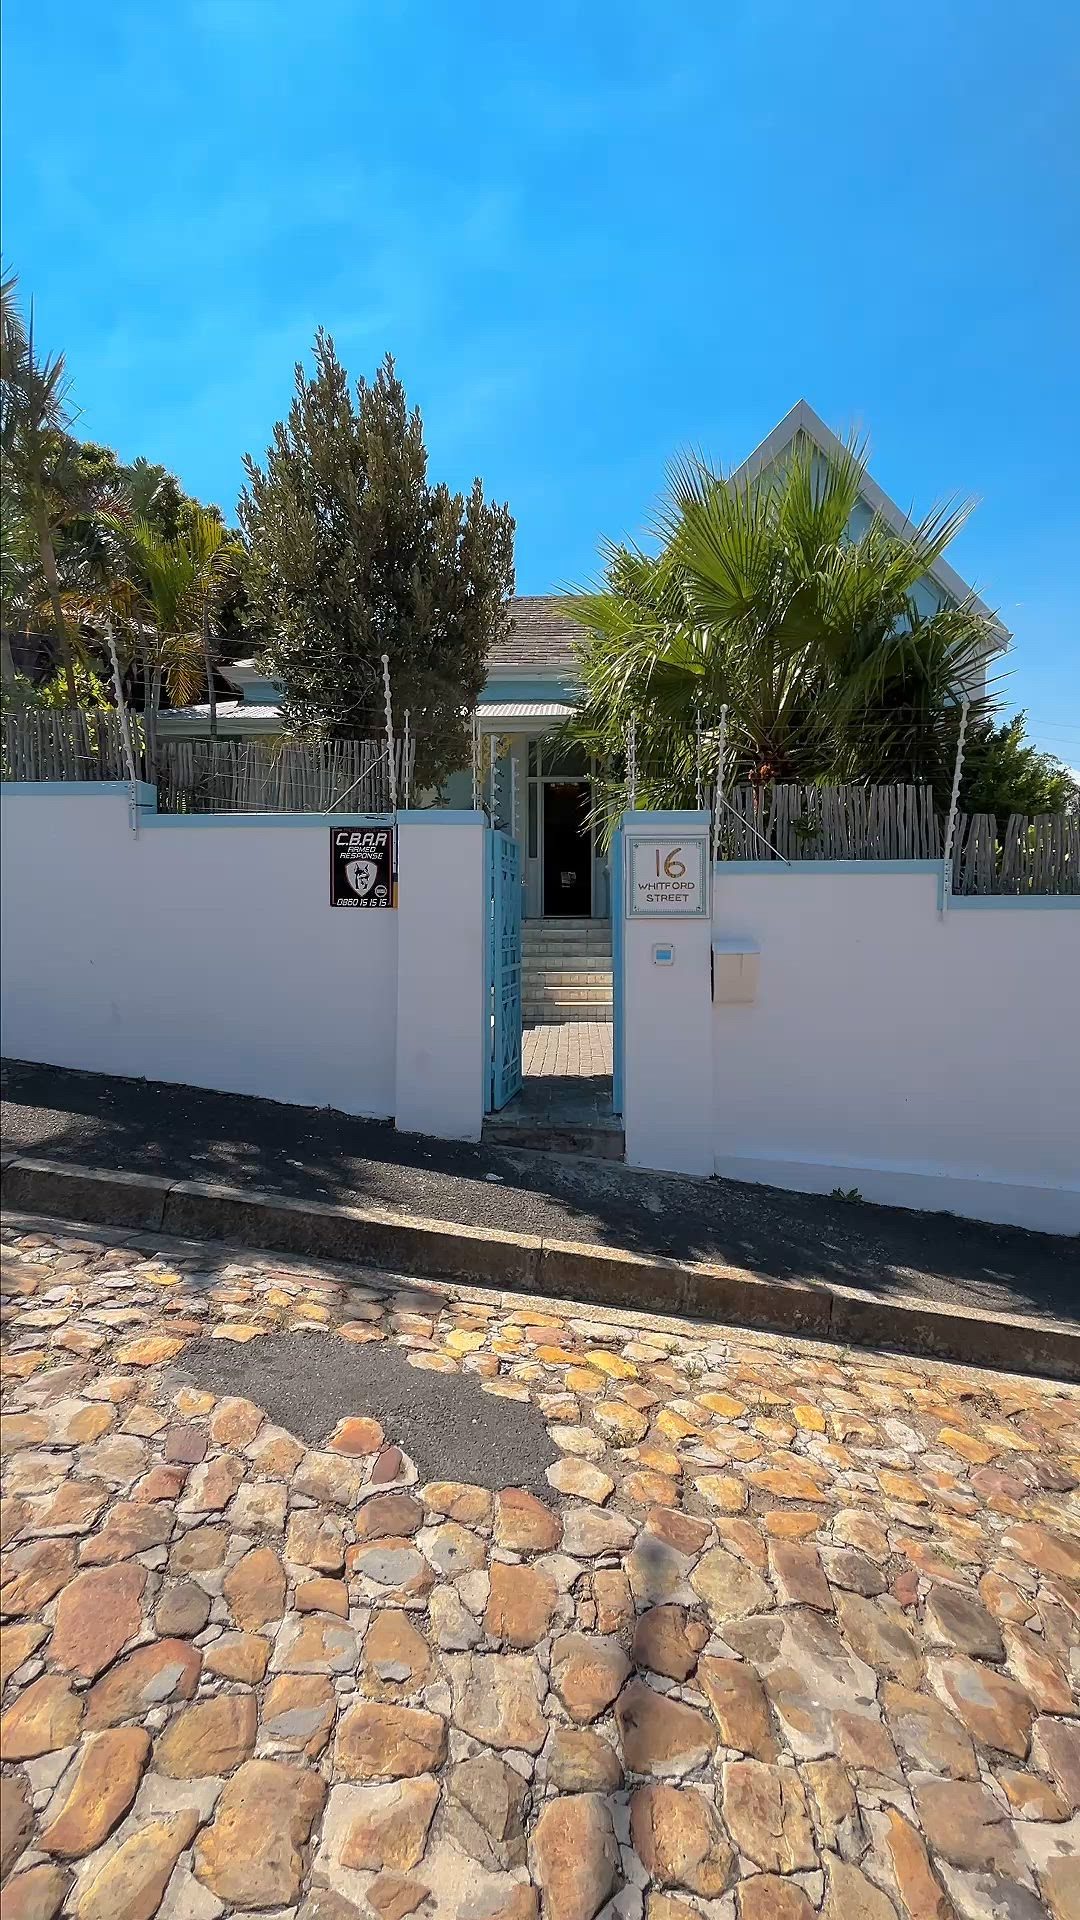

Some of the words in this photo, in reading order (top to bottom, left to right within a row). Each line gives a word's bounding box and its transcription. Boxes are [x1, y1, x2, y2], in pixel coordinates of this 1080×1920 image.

[655, 847, 686, 878] 16
[638, 881, 695, 891] WHITFORD
[359, 898, 369, 907] 15
[369, 898, 378, 907] 15
[378, 898, 388, 907] 15
[646, 893, 689, 903] STREET
